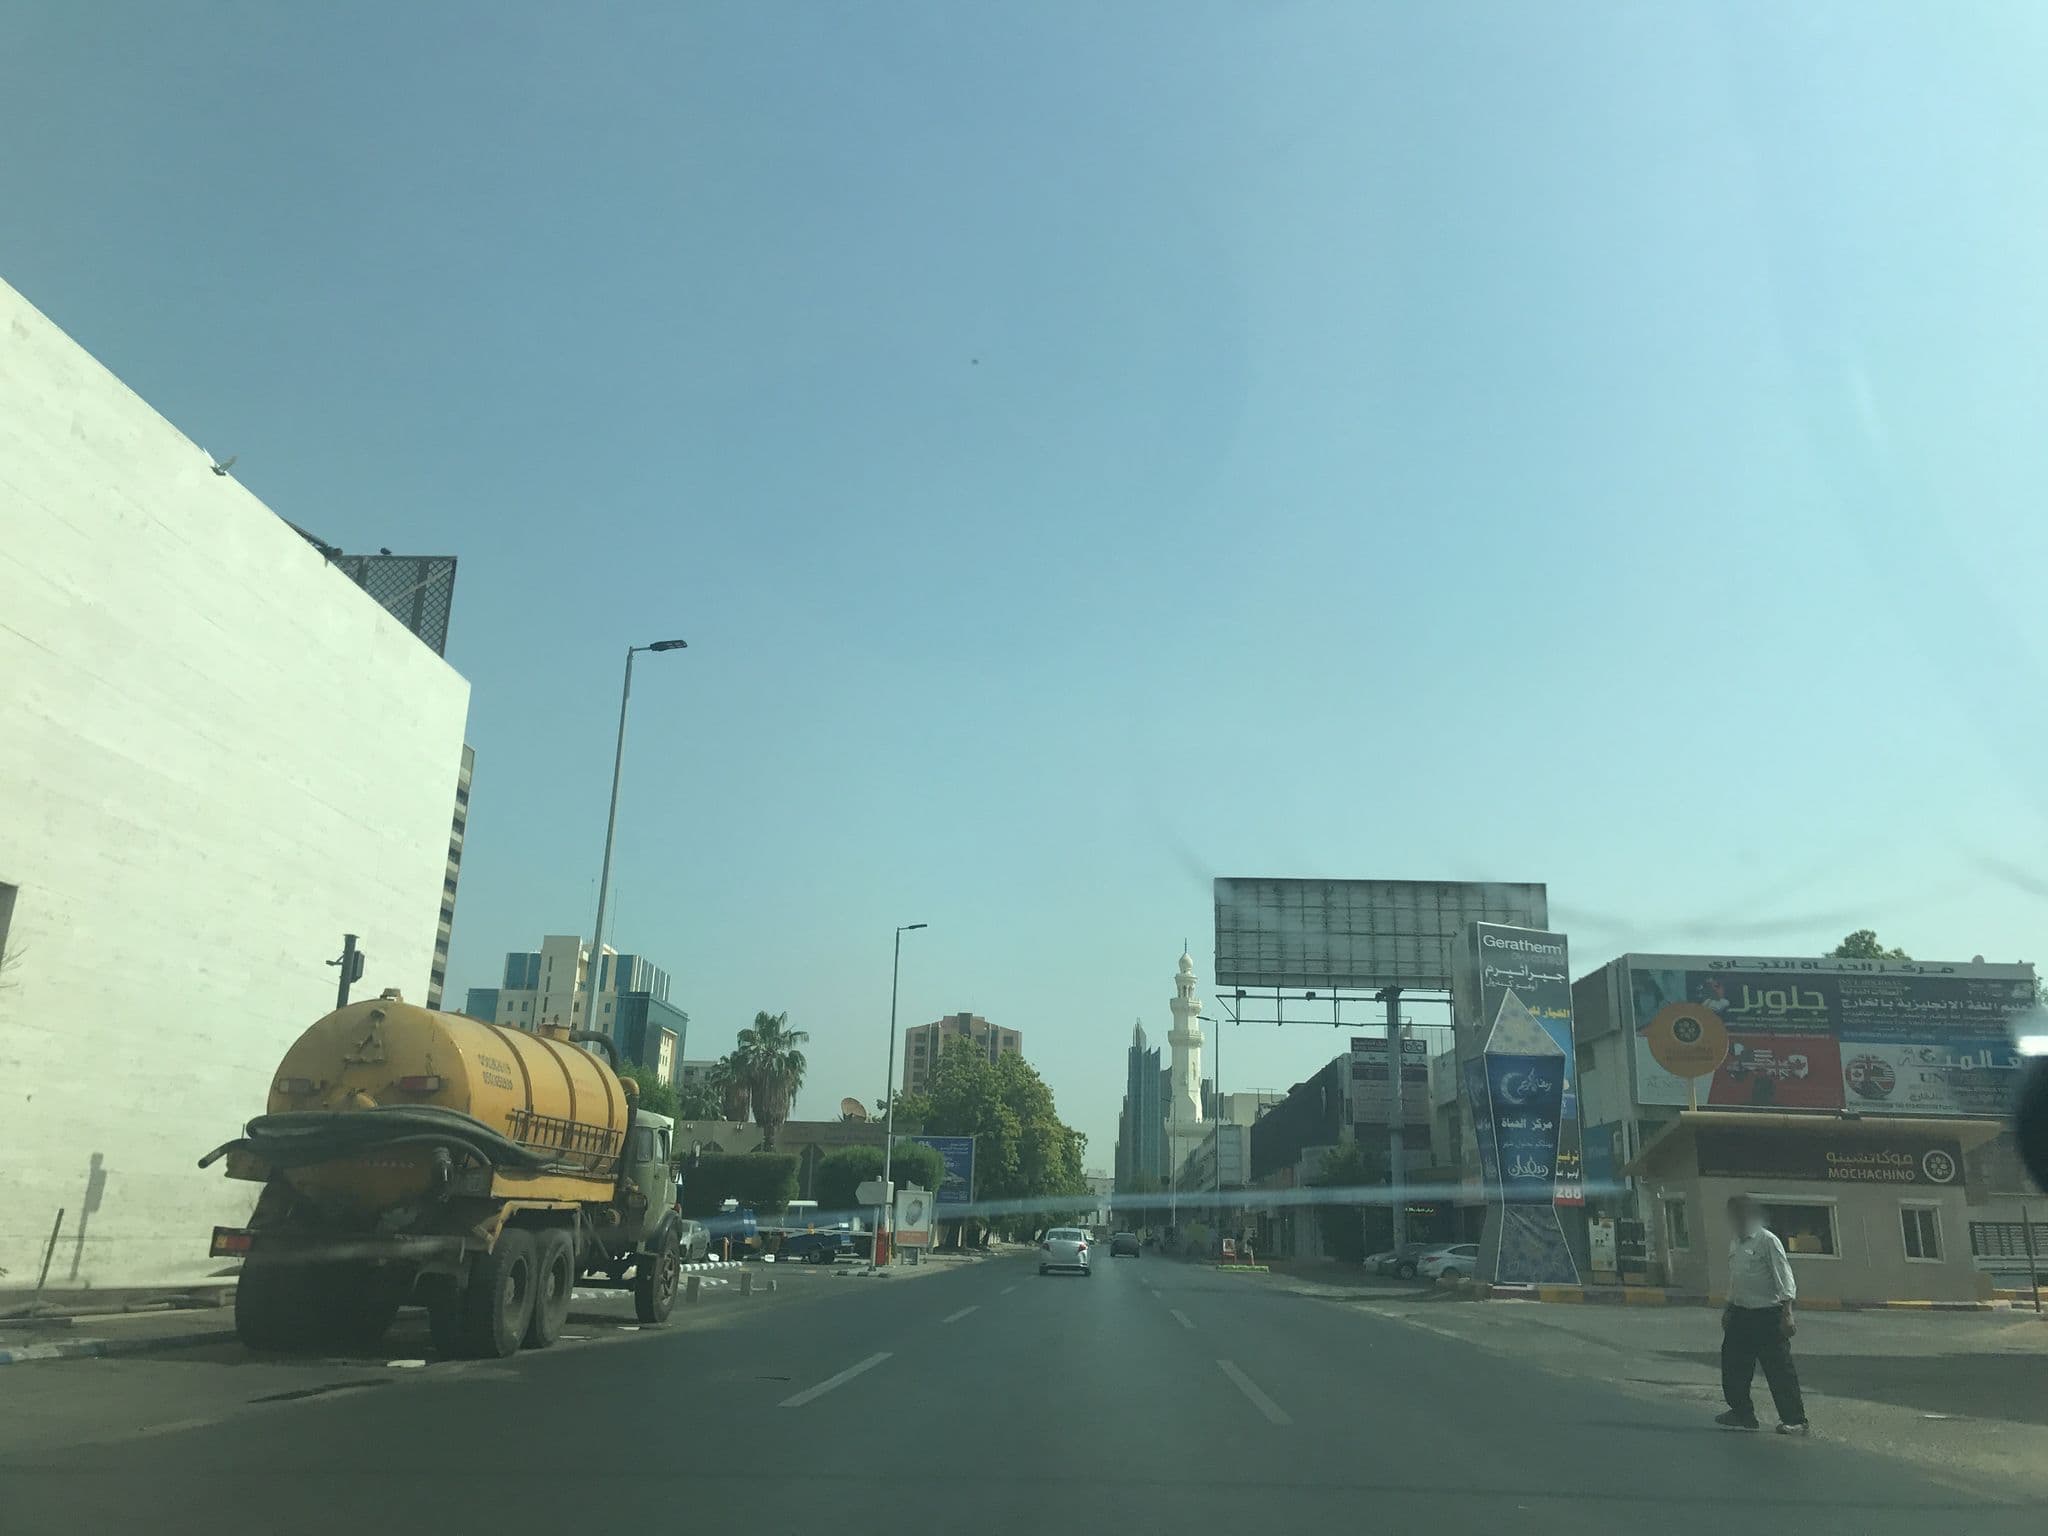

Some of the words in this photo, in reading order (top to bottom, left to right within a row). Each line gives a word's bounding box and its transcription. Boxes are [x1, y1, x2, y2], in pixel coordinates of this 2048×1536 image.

[1482, 934, 1562, 954] Geratherm
[1800, 961, 1873, 972] الحياة
[1878, 964, 1955, 974] مركز
[1727, 984, 1829, 1015] جلوبل
[1967, 999, 1998, 1011] اللغة
[1501, 1117, 1527, 1129] الحياة
[1531, 1118, 1553, 1131] مركز
[1828, 1167, 1916, 1181] MOCHACHINO
